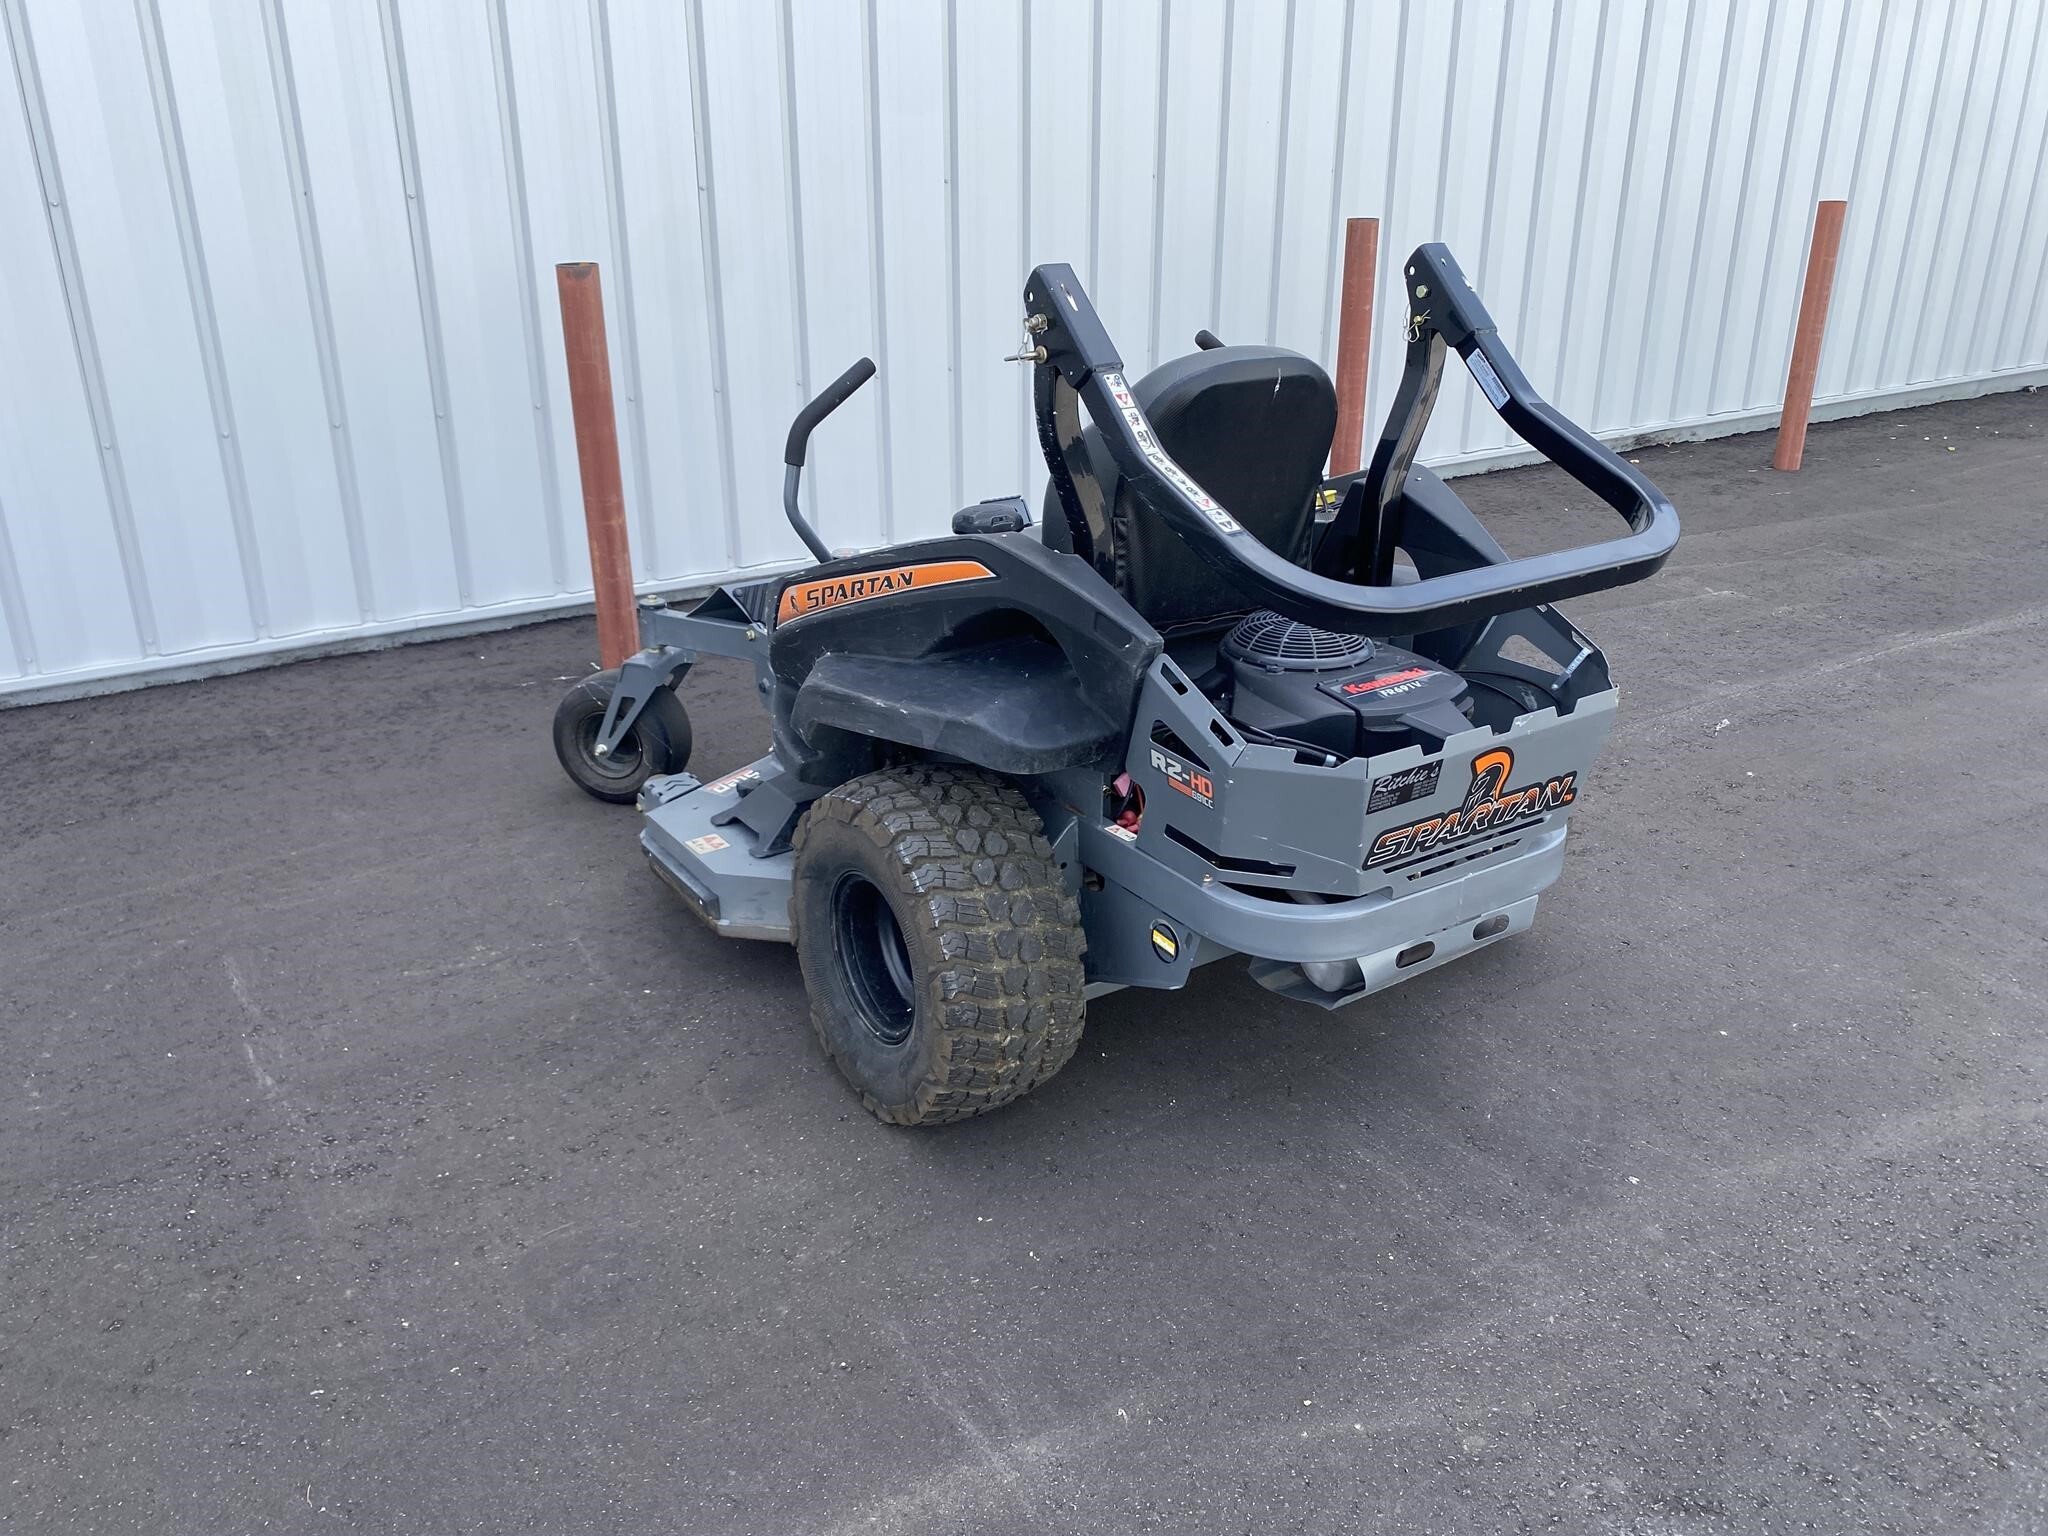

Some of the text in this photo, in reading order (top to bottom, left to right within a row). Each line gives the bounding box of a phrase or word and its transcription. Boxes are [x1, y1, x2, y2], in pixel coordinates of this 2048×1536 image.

[806, 572, 914, 609] SPARTAN
[1342, 667, 1427, 695] Kawasaki
[1150, 748, 1214, 799] RZ-HD
[1372, 761, 1440, 797] Ritchie's
[1366, 775, 1574, 867] SPARTAN
